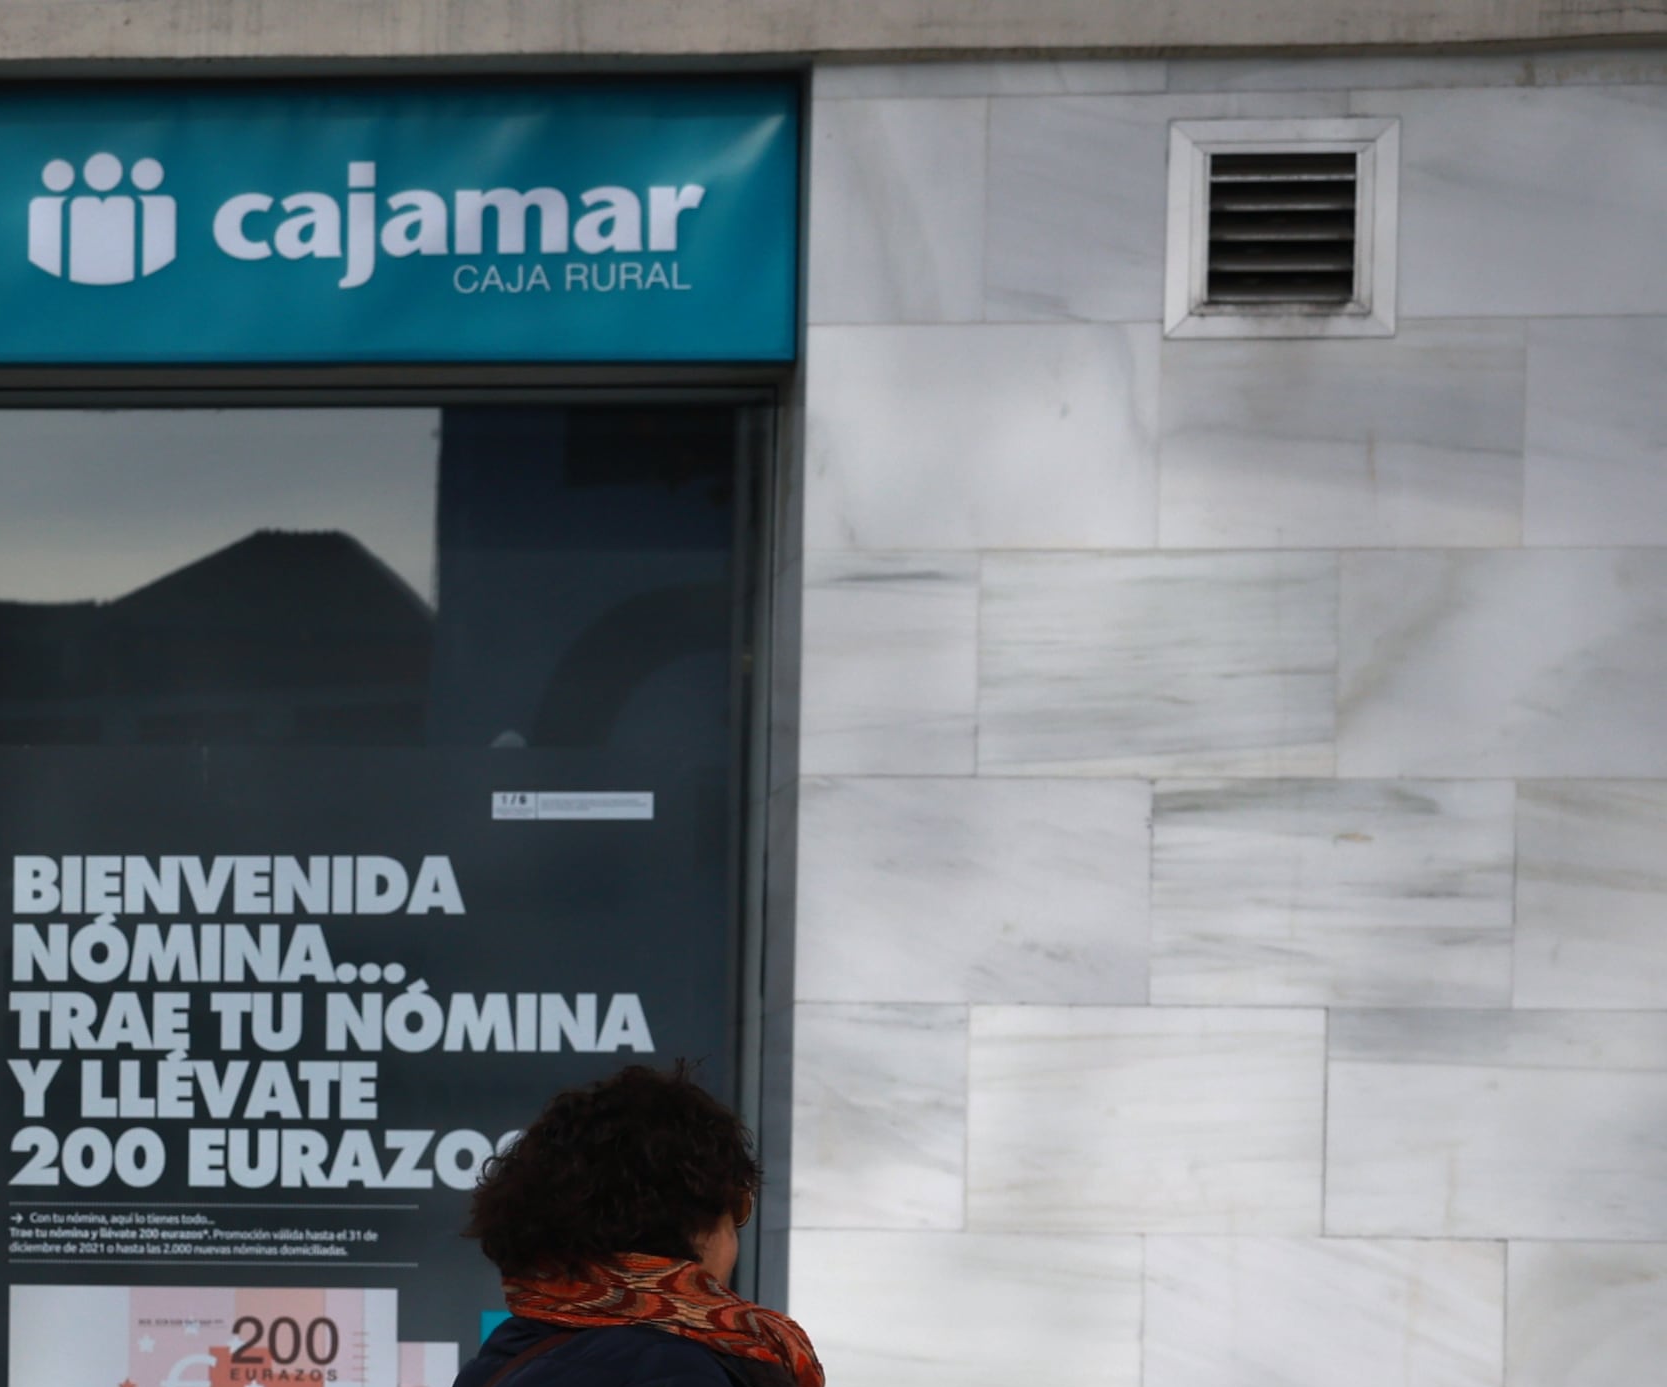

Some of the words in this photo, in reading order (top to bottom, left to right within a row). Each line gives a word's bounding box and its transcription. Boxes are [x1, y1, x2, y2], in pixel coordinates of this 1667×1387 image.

[213, 161, 705, 289] cajamar
[453, 265, 552, 295] CAJA
[564, 263, 691, 292] RURAL
[13, 855, 465, 914] BIENVENIDA
[12, 913, 405, 983] NÓMINA...
[9, 992, 190, 1051] TRAE
[210, 992, 302, 1052] TU
[326, 978, 655, 1054] NÓMINA
[8, 1060, 62, 1118] Y
[81, 1049, 377, 1119] LLÉVATE
[8, 1127, 166, 1187] 200
[9, 1227, 33, 1238] Trae
[35, 1228, 47, 1238] tu
[49, 1227, 89, 1239] nómina
[139, 1228, 160, 1239] 200
[213, 1228, 271, 1240] Promoción
[305, 1229, 334, 1241] hasta
[348, 1230, 362, 1241] 31
[363, 1230, 378, 1242] de
[29, 1212, 52, 1223] Con
[52, 1212, 65, 1223] tu
[147, 1213, 180, 1224] tienes
[9, 1242, 61, 1253] diciembre
[63, 1242, 77, 1253] de
[79, 1242, 105, 1254] 2021
[115, 1242, 144, 1254] hasta
[194, 1245, 231, 1255] nuevas
[233, 1243, 278, 1256] nóminas
[230, 1316, 339, 1365] 200
[230, 1369, 338, 1382] EURAZOS
